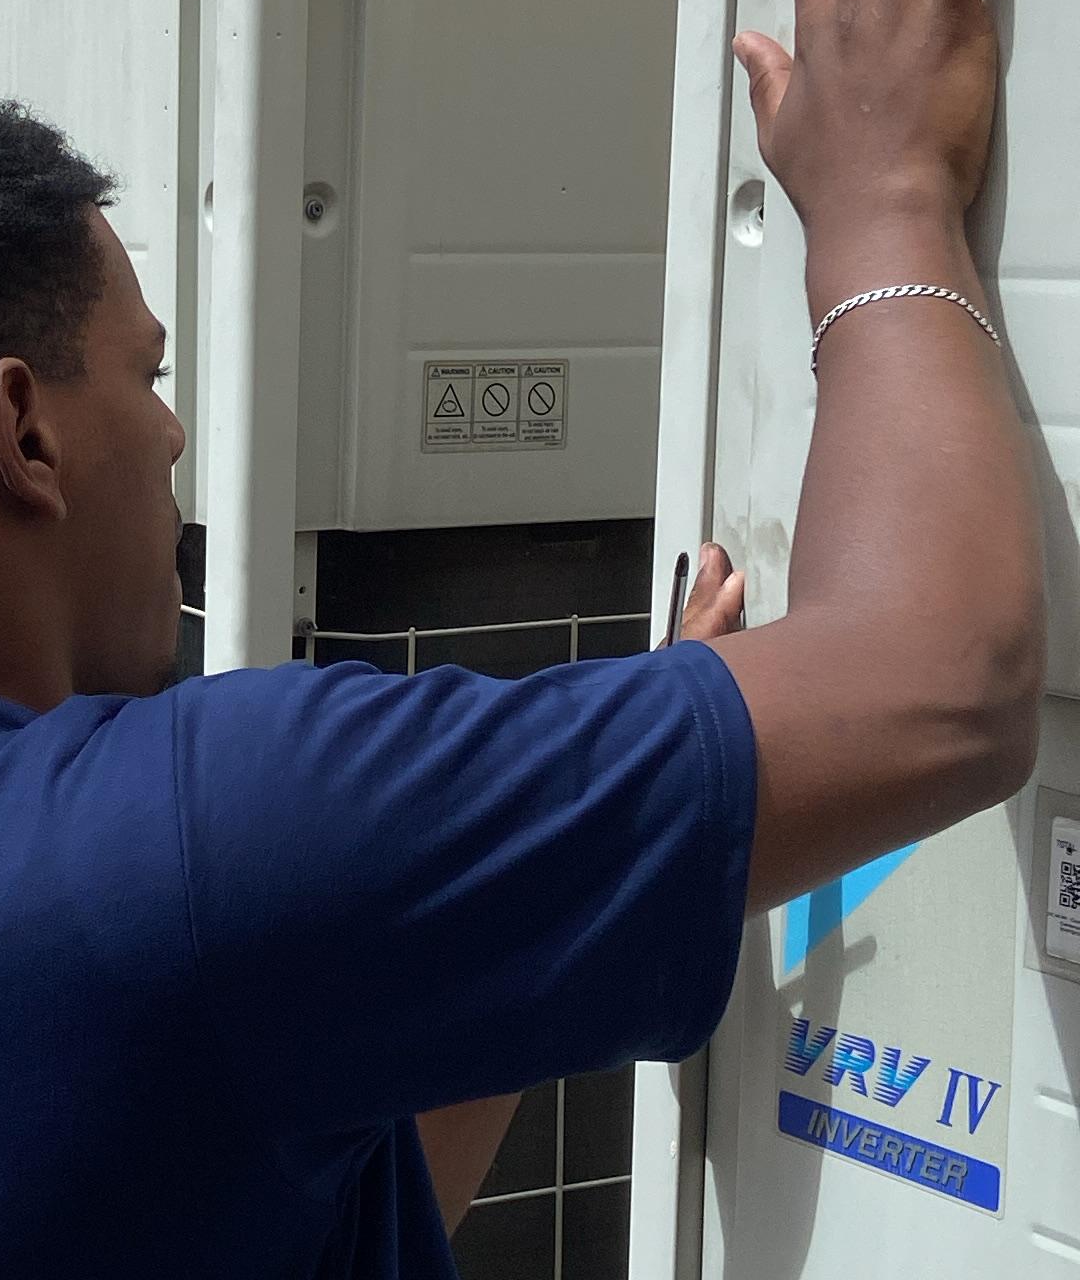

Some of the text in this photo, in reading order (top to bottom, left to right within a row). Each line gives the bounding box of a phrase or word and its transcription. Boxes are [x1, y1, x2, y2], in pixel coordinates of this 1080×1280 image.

[784, 1017, 1002, 1135] VRV IV
[807, 1108, 969, 1192] INVERTER
